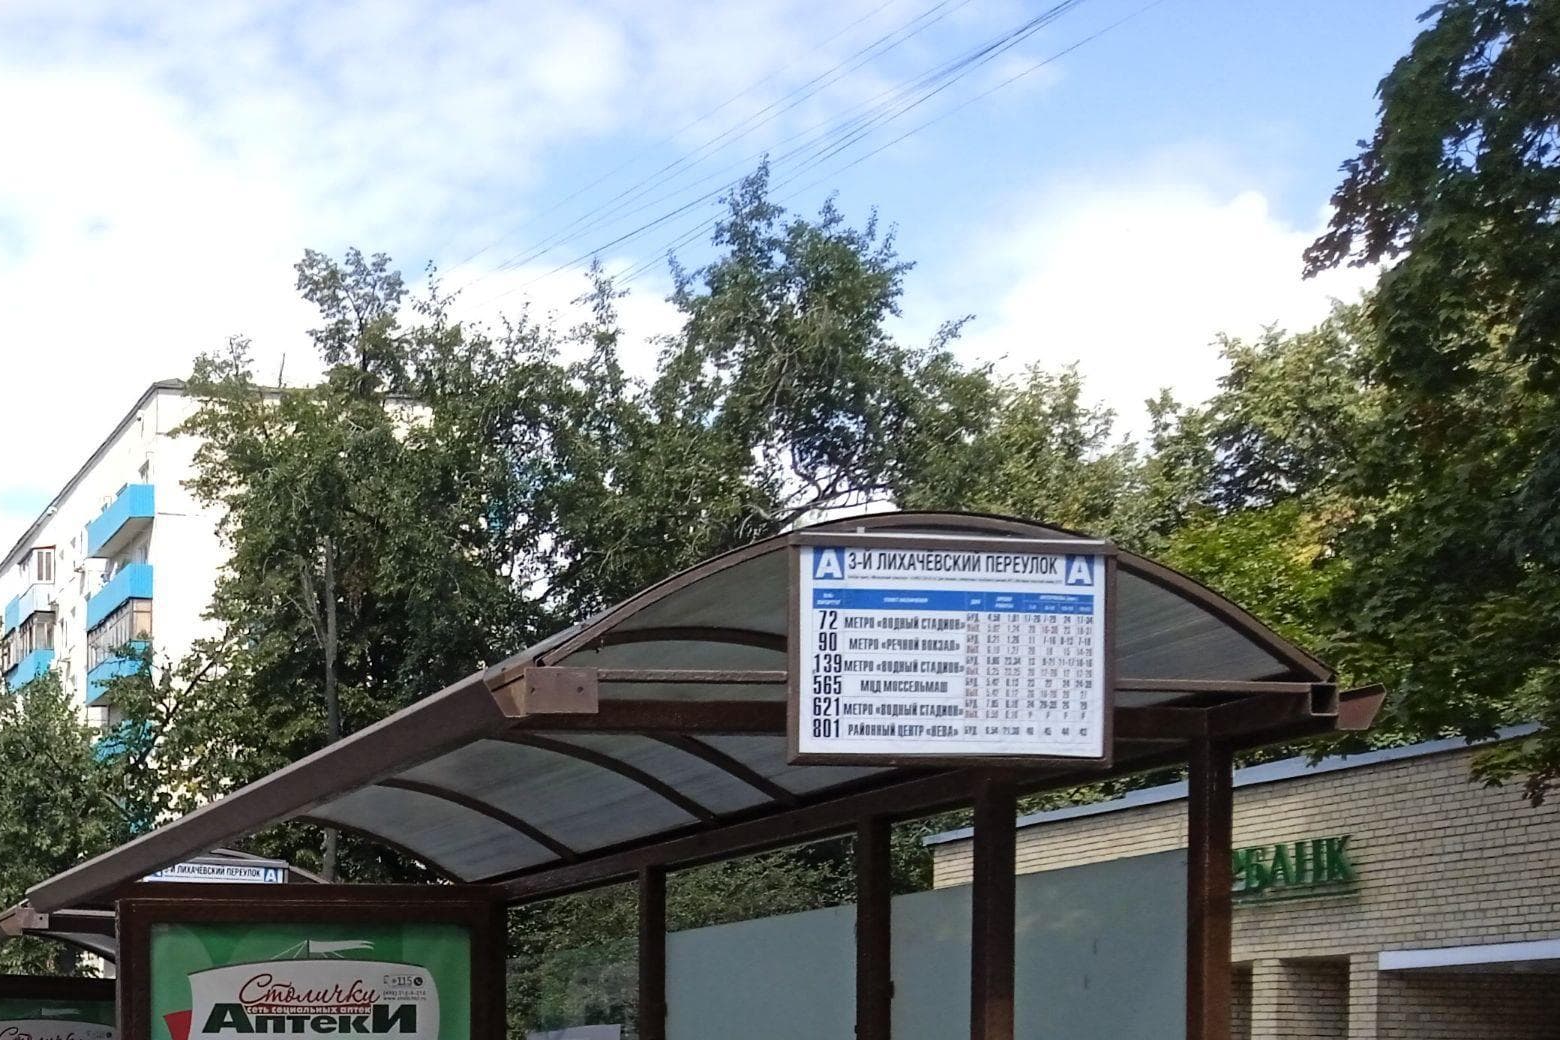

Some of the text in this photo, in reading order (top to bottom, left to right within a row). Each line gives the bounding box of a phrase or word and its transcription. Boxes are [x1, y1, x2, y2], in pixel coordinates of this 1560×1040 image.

[985, 554, 1058, 576] ПЕРЕУЛОК
[819, 610, 838, 630] 72
[844, 616, 874, 629] МЕТРО
[819, 631, 838, 651] 90
[849, 638, 879, 651] МЕТРО
[814, 653, 842, 673] 139
[844, 660, 874, 672] МЕТРО
[813, 675, 842, 695] 565
[813, 696, 840, 717] 621
[843, 703, 873, 716] МЕТРО
[813, 718, 840, 738] 801
[848, 722, 896, 736] РАЙОННЫЙ
[897, 725, 924, 738] ЦЕНТР
[226, 867, 261, 878] ПЕРЕУЛОК
[239, 973, 381, 1006] Столички
[246, 1005, 371, 1015] сеть социальных аптек
